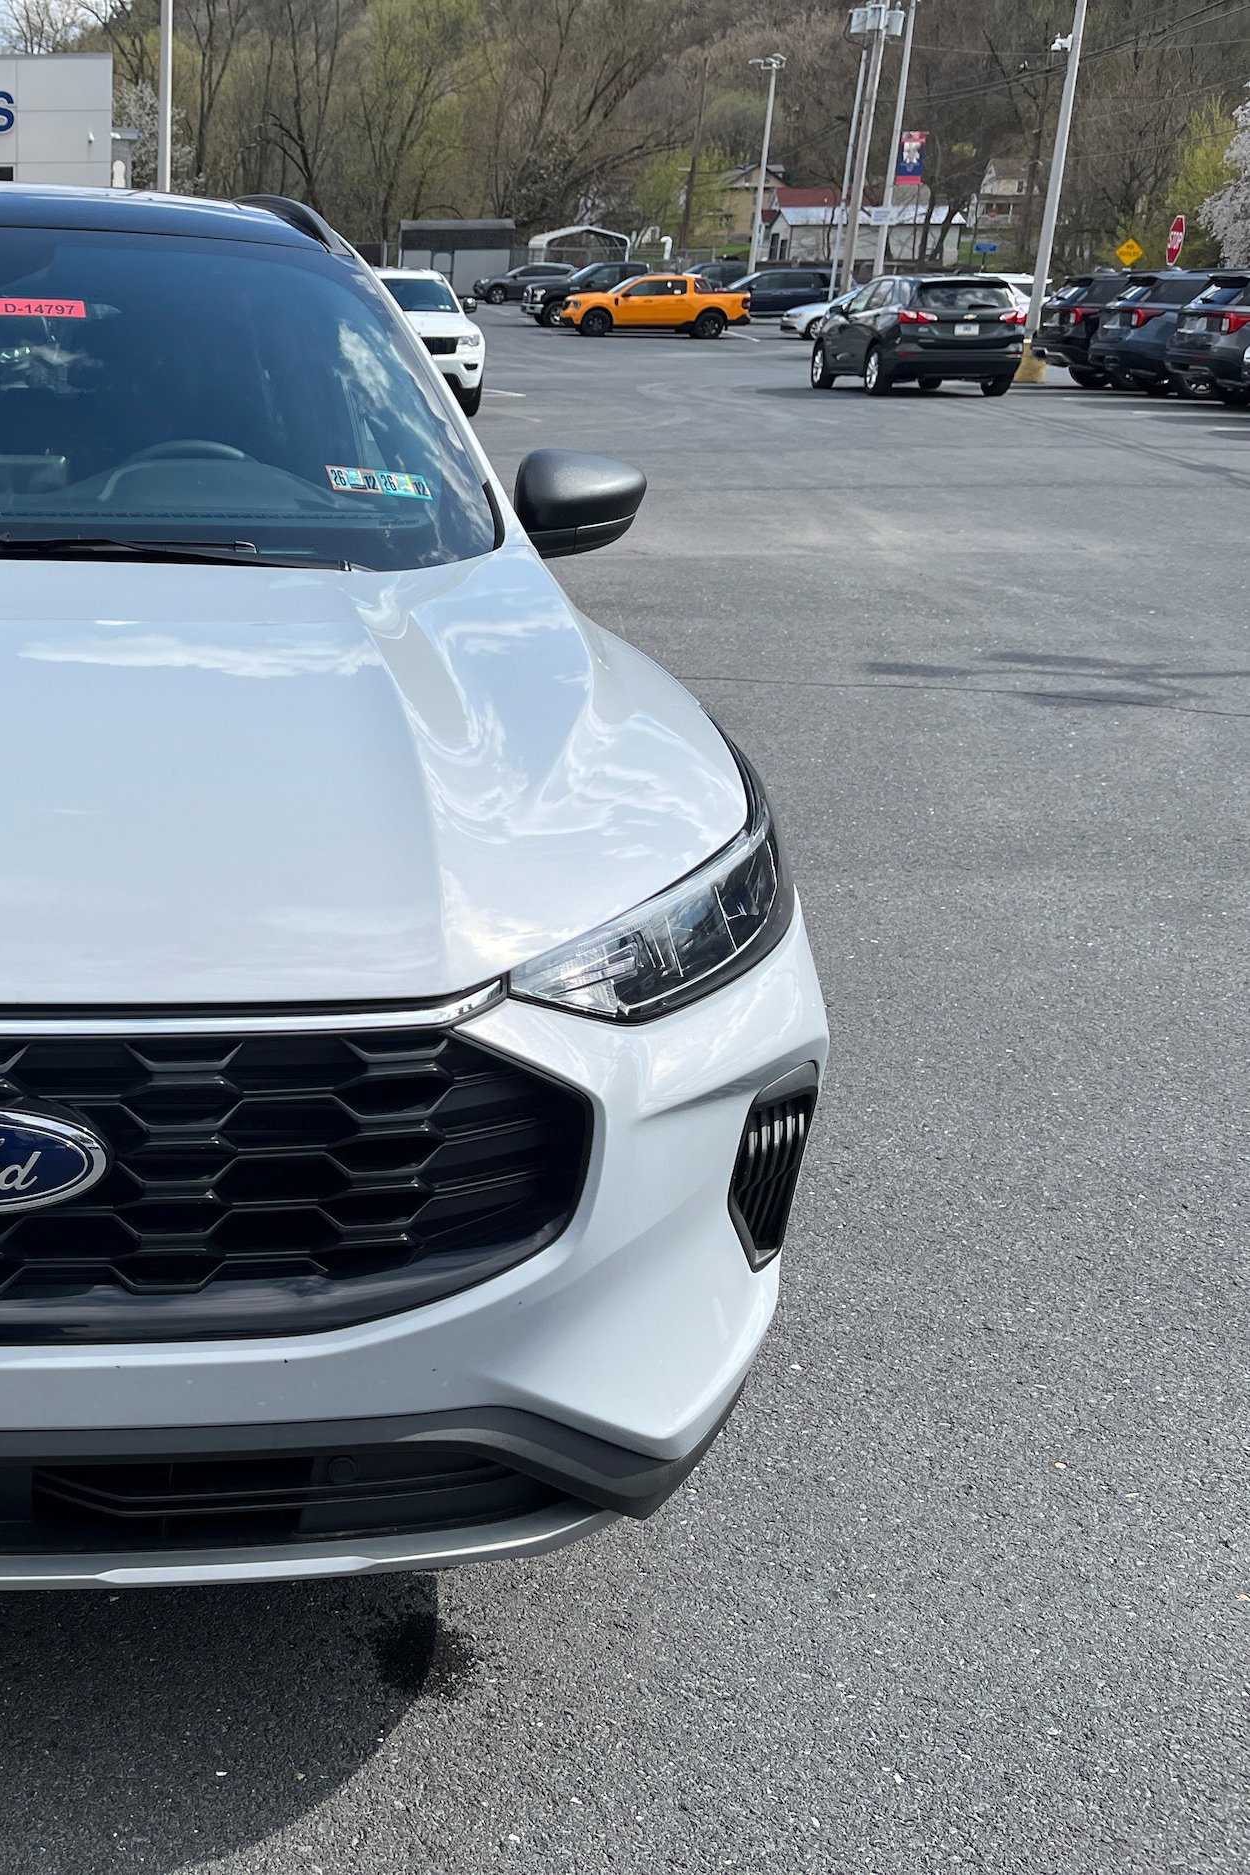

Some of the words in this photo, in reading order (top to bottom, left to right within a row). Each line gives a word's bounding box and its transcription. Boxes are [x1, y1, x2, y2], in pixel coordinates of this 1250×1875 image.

[1167, 231, 1183, 250] STOP
[4, 303, 75, 315] D-14797
[330, 469, 347, 487] 26
[363, 475, 379, 491] 12
[380, 474, 398, 492] 26
[413, 481, 430, 497] 12
